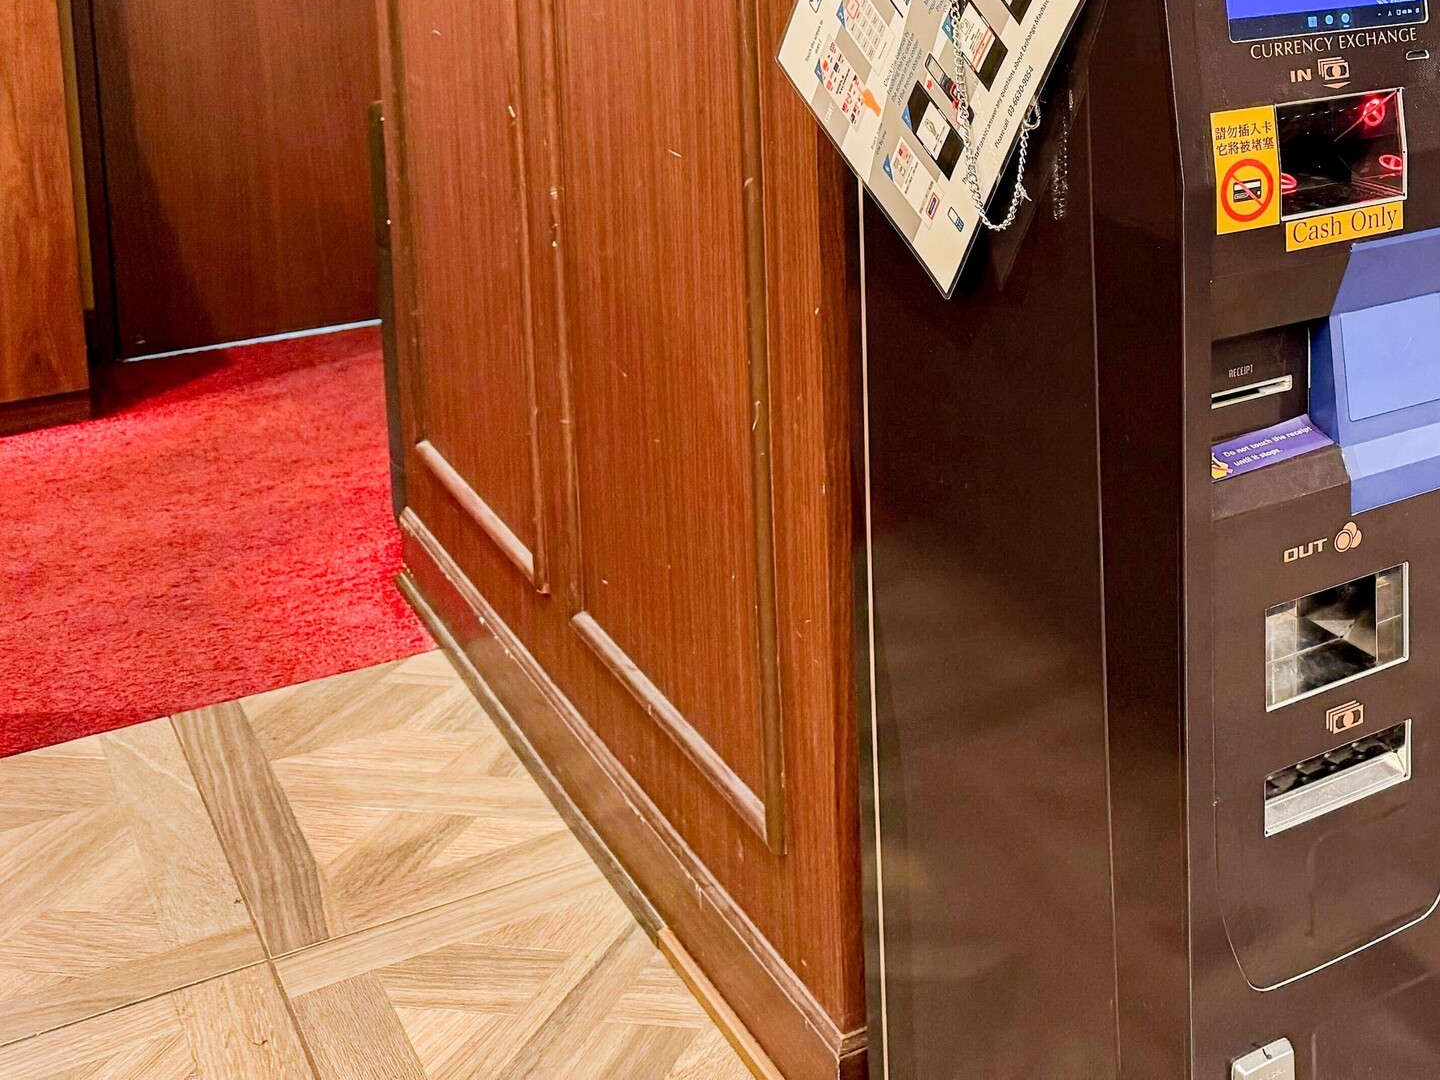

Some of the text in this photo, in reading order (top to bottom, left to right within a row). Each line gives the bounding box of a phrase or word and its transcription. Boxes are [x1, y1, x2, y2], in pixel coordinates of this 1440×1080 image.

[1250, 27, 1417, 60] CURRENCY EXCHANGE
[1000, 23, 1036, 98] questions about Exchange
[1290, 68, 1312, 83] IN
[824, 103, 833, 124] START
[994, 129, 1004, 148] Please
[1007, 65, 1033, 116] 03-6630-9054
[1215, 120, 1273, 141] 請勿插入卡
[1216, 137, 1274, 157] 它將被堵塞
[1293, 207, 1398, 243] Cash Only
[1228, 364, 1253, 379] RECEIPT
[1223, 426, 1312, 459] Do not touch the receipt
[1233, 448, 1283, 467] until it stops.
[1284, 538, 1328, 563] OUT
